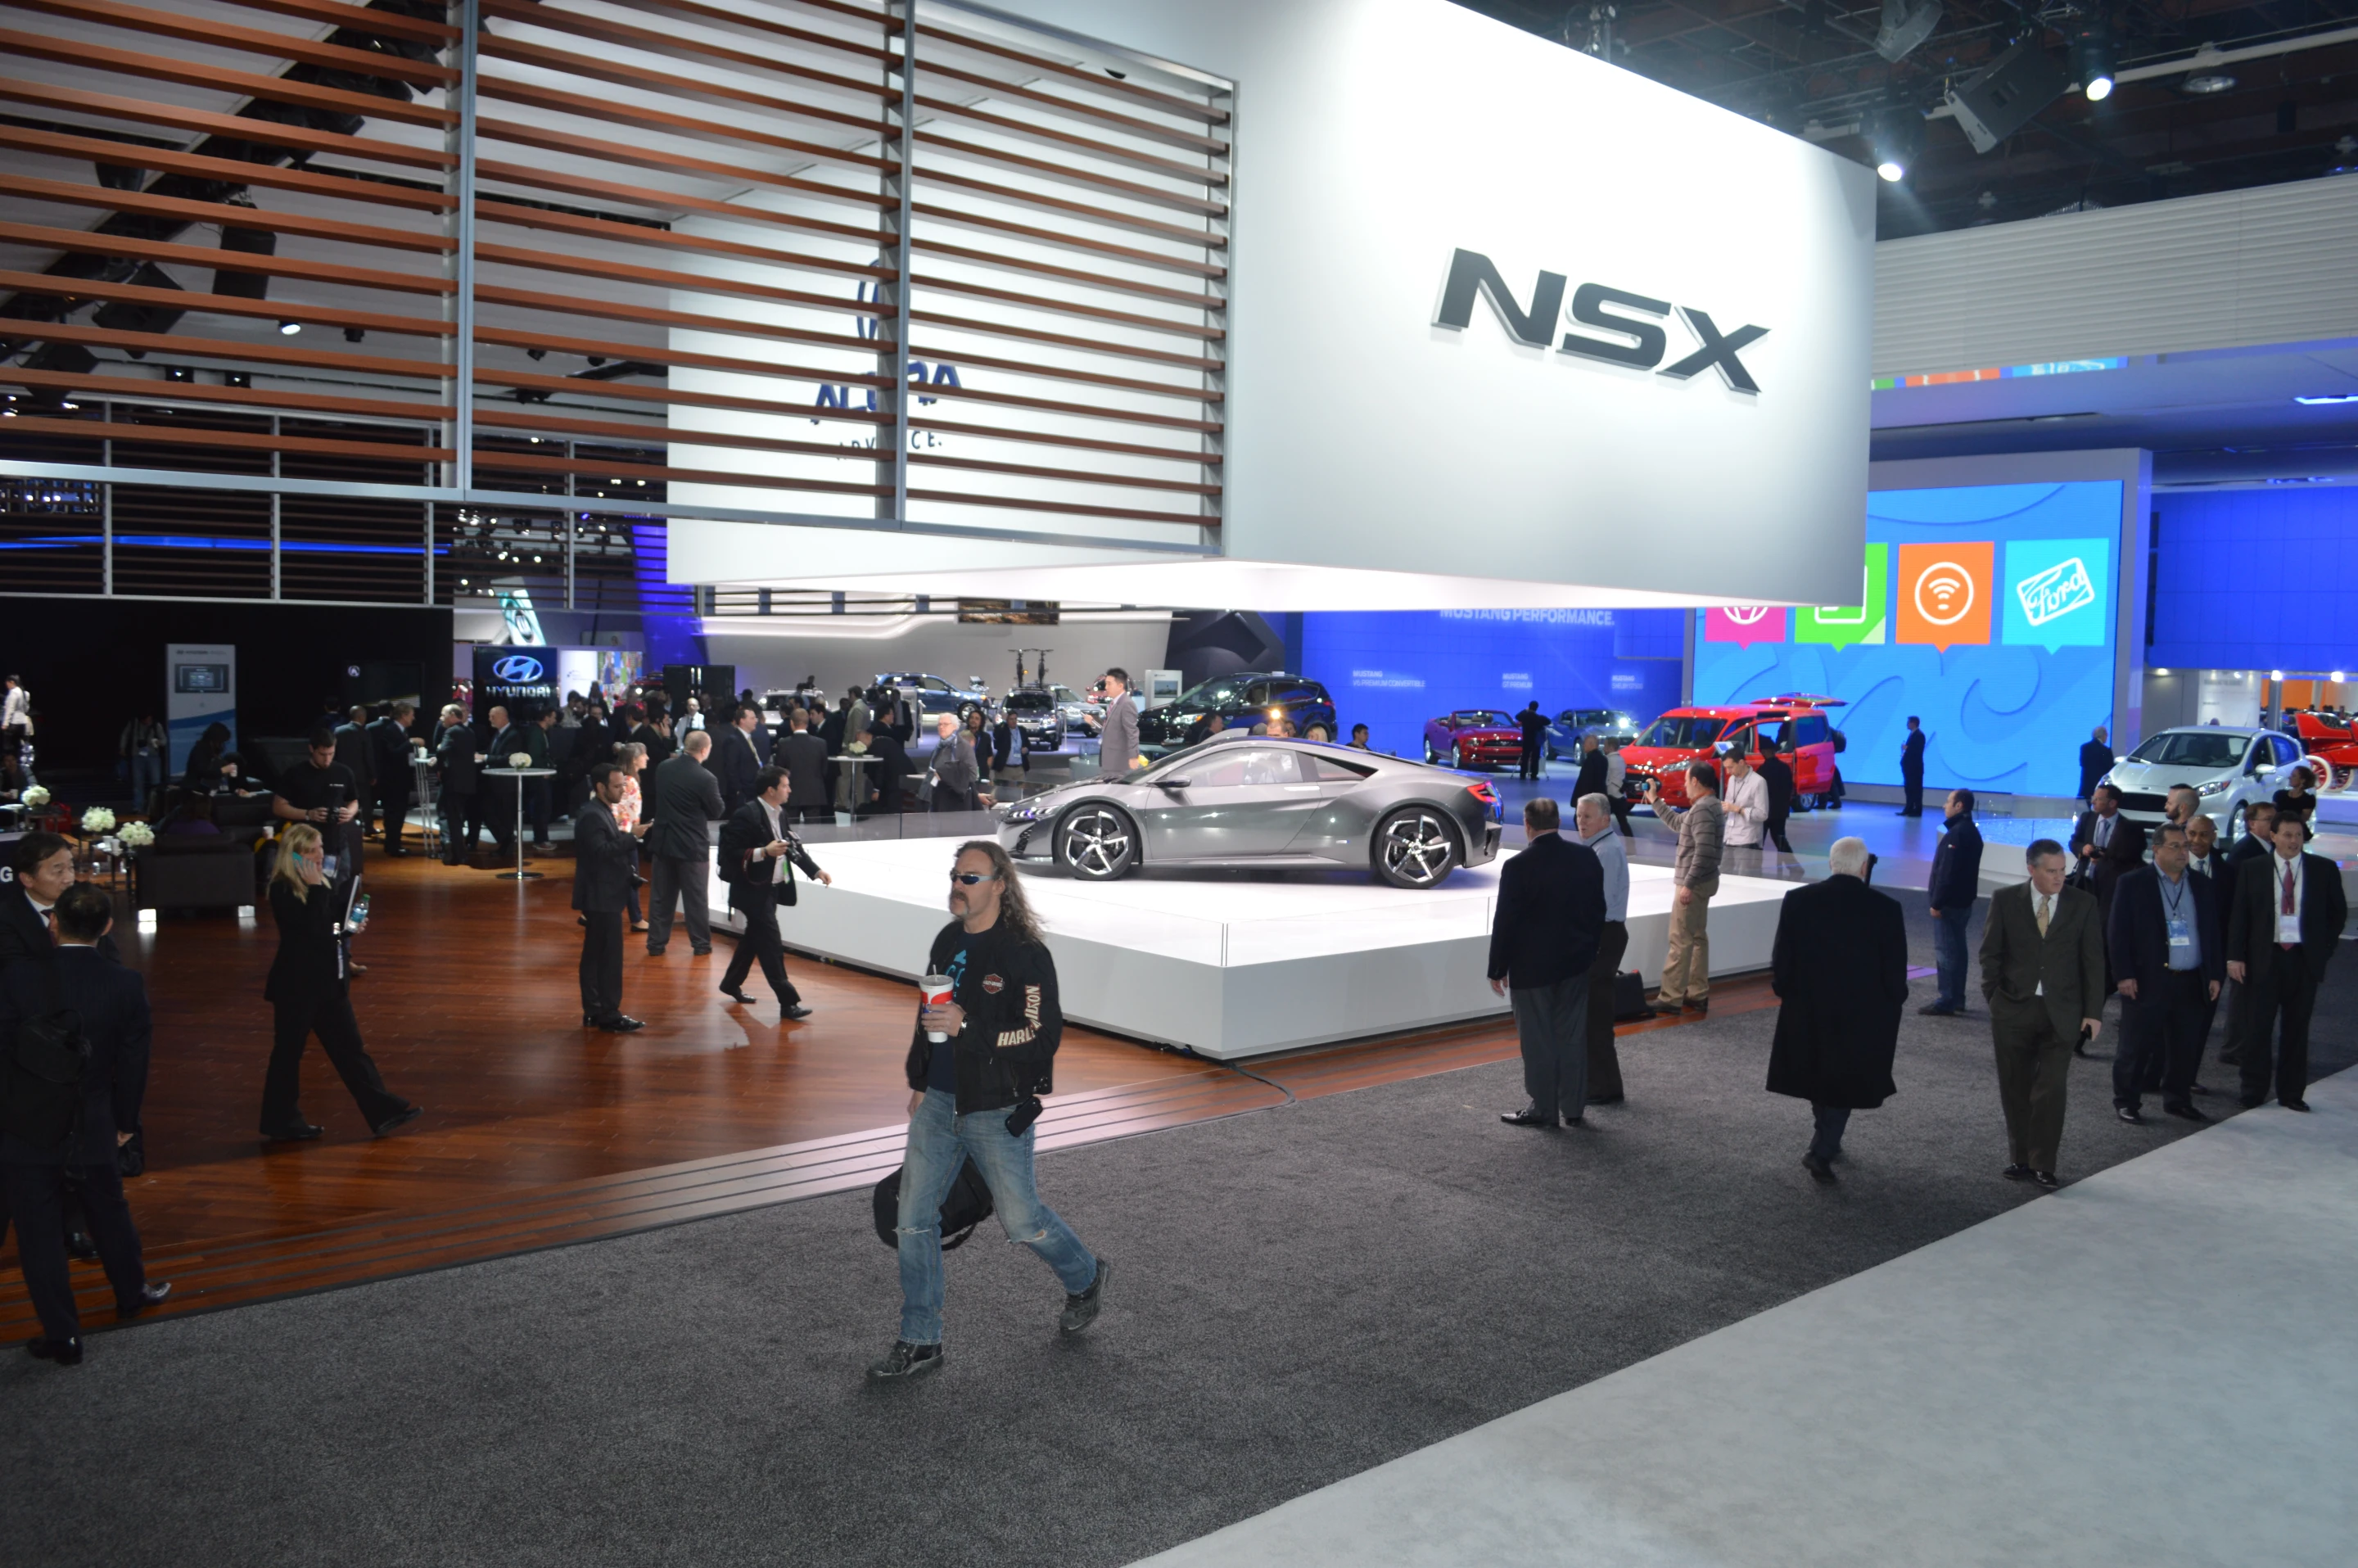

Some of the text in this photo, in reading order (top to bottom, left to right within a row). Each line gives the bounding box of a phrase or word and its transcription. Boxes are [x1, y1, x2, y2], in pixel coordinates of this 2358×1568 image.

[1430, 247, 1772, 396] NSX
[2026, 562, 2087, 621] Ford
[486, 685, 551, 698] HYUNDAI
[1389, 680, 1426, 688] CONVERTIBLE
